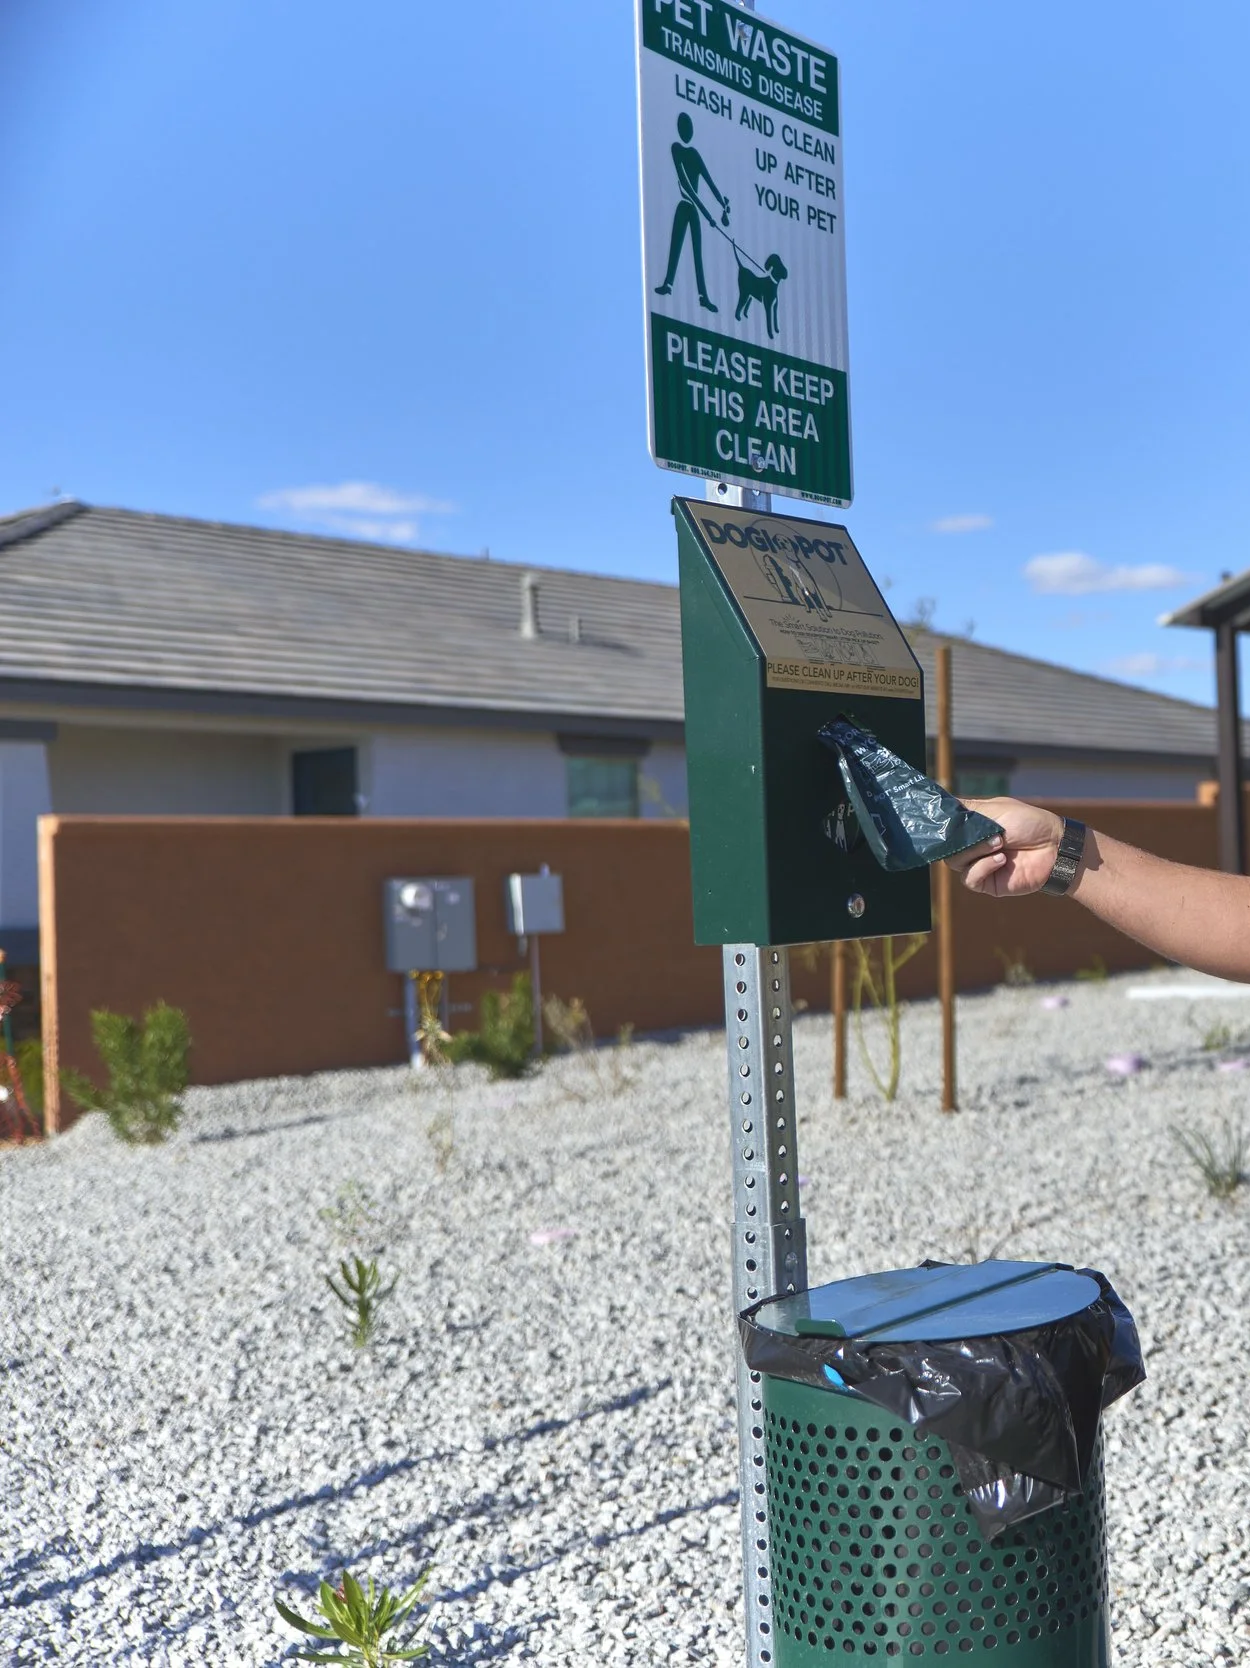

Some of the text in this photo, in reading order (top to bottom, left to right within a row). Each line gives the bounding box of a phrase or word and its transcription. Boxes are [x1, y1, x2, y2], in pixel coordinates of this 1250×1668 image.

[661, 26, 823, 121] TRANSMITS DISEASE
[725, 12, 827, 94] WASTE
[675, 74, 835, 165] LEASH AND CLEAN
[755, 148, 836, 200] UP AFTER
[755, 183, 836, 234] YOUR PET
[667, 332, 834, 406] PLEASE KEEP
[687, 380, 819, 442] THIS AREA
[716, 429, 796, 476] CLEAN
[767, 662, 800, 676] PLEASE
[802, 666, 831, 680] CLEAN
[833, 670, 844, 680] UP
[846, 671, 872, 684] AFTER
[874, 673, 897, 686] YOUR
[898, 676, 919, 688] DOG!
[892, 778, 914, 793] Smart
